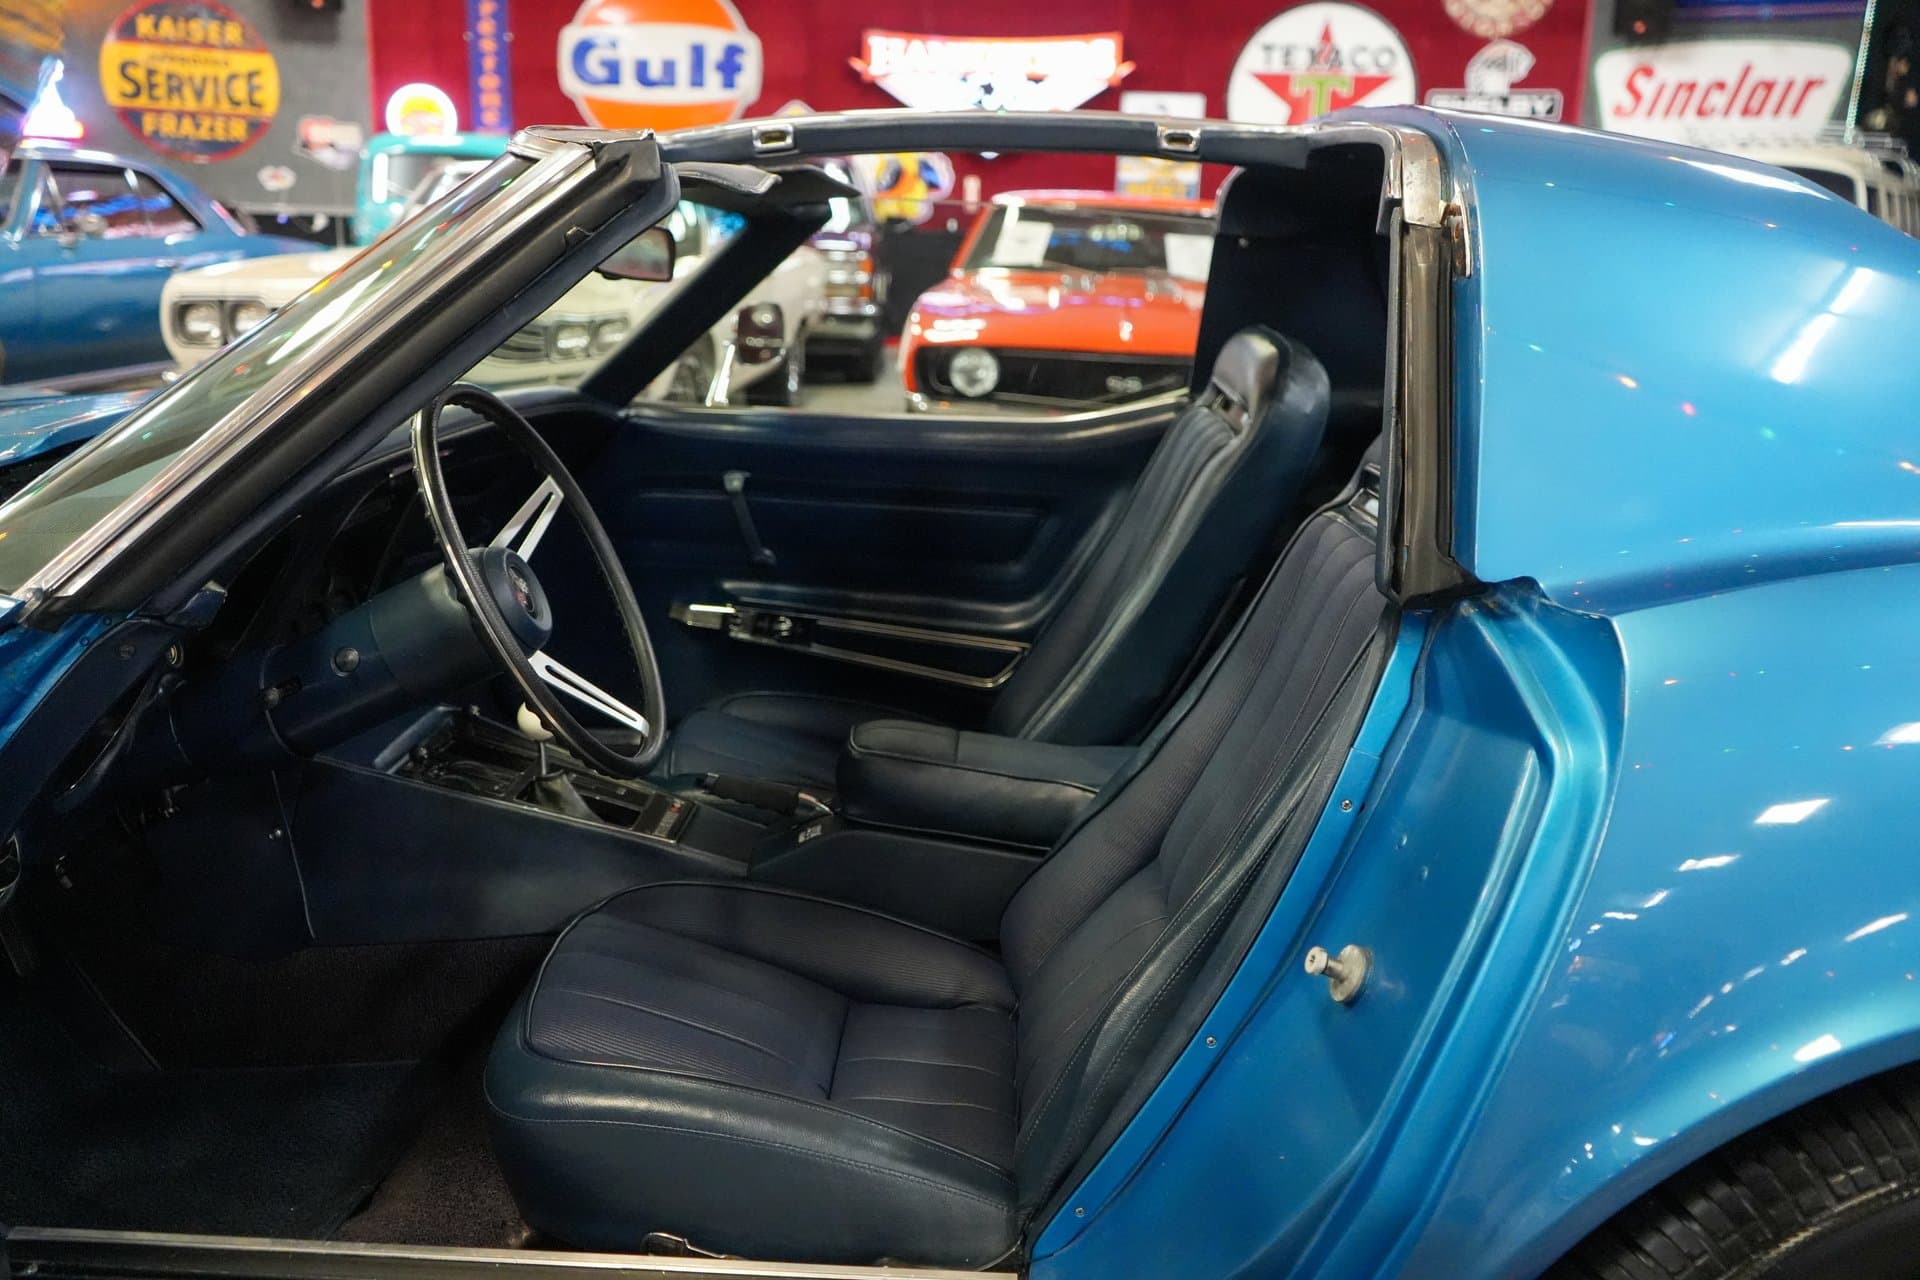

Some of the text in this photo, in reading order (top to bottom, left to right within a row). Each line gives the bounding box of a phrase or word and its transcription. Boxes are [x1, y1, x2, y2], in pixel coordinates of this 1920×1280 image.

[135, 13, 244, 46] KAISER
[572, 37, 745, 89] Gulf
[1261, 44, 1396, 69] TEXACO
[119, 60, 264, 109] SERVICE
[1612, 63, 1825, 118] Sinclair
[142, 111, 249, 143] FRAZER
